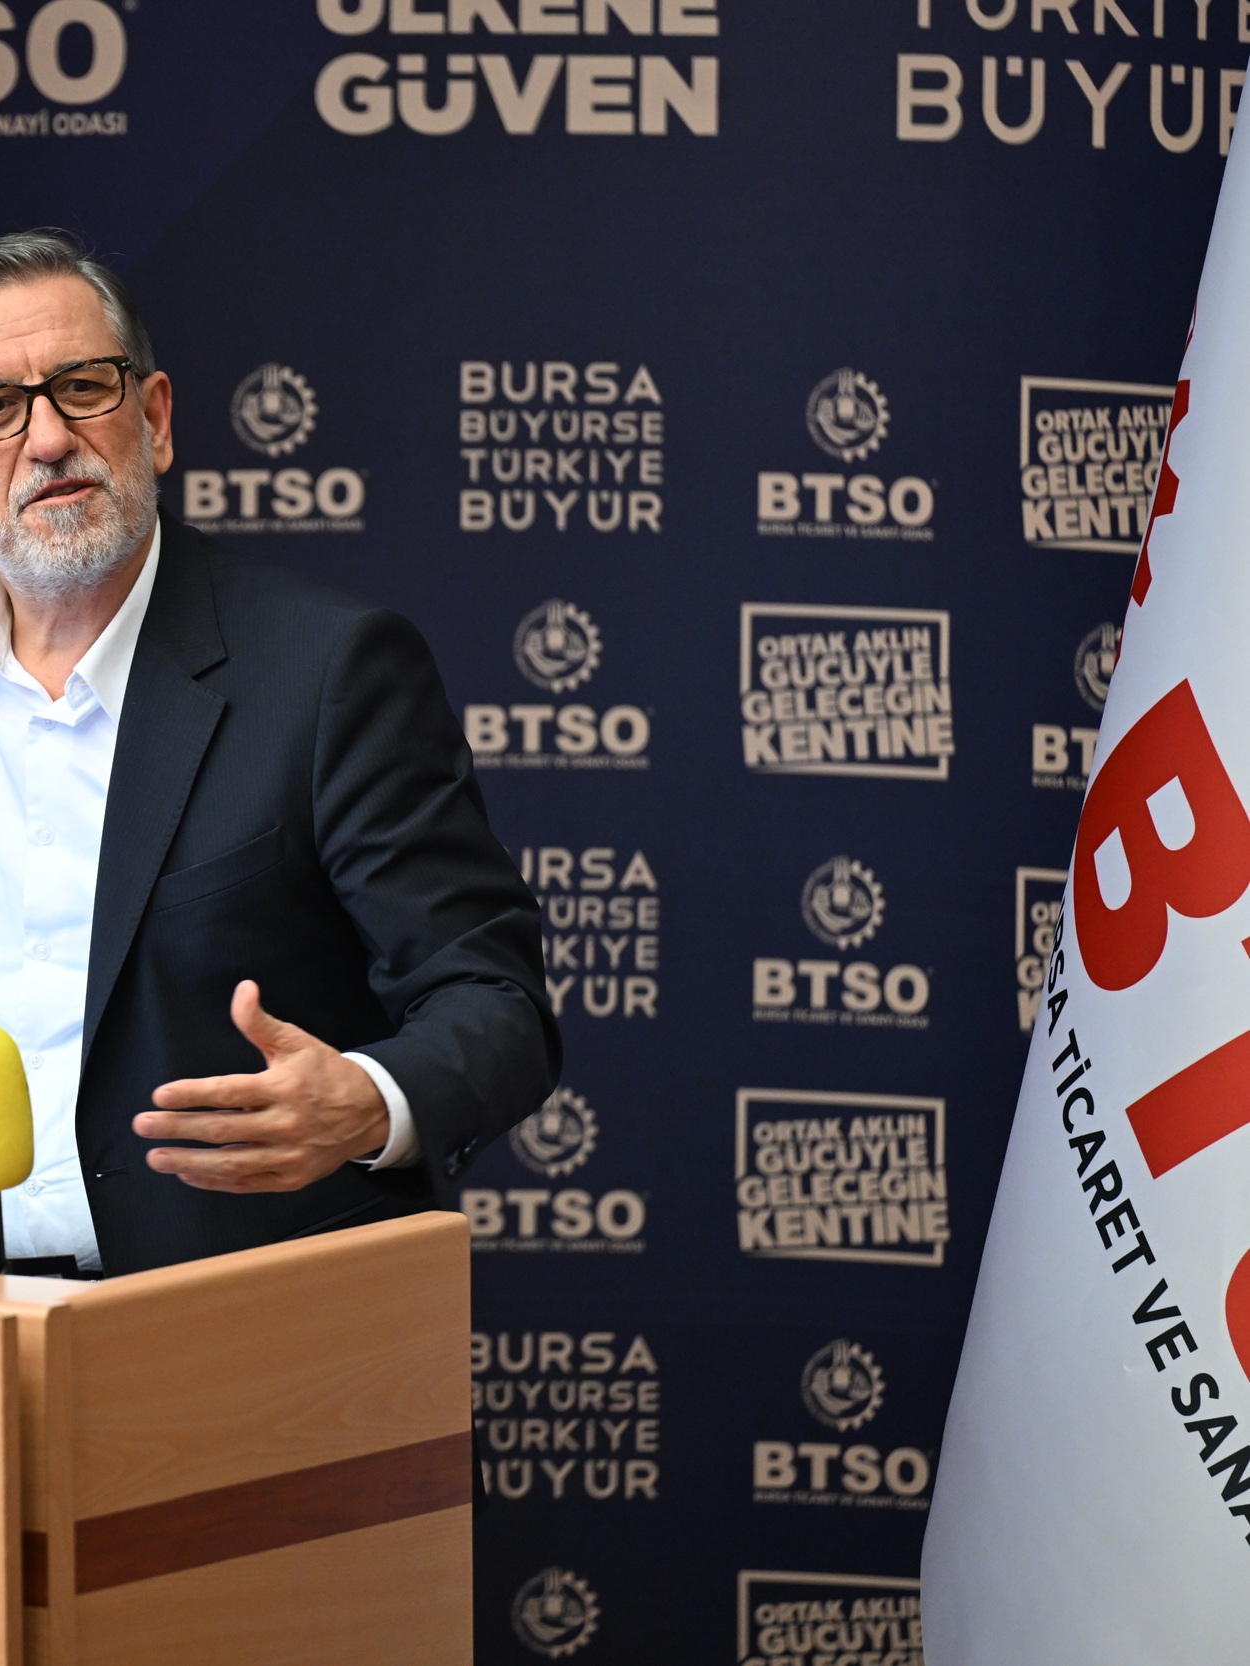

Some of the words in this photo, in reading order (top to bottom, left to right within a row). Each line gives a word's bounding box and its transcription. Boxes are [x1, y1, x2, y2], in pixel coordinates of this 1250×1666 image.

[314, 52, 721, 136] GÜVEN
[52, 111, 128, 137] ODASI
[459, 361, 662, 404] BURSA
[1035, 408, 1112, 434] ORTAK
[183, 467, 365, 519] BTSO
[459, 489, 663, 532] BÜYÜR
[757, 471, 934, 526] BTSO
[757, 631, 848, 660] ORTAK
[853, 627, 931, 651] AKLIN
[464, 704, 650, 756] BTSO
[1032, 723, 1100, 776] BT
[521, 846, 658, 893] RSA
[539, 895, 660, 931] ÜRSE
[546, 974, 659, 1018] YÜR
[752, 957, 930, 1014] BTSO
[460, 1188, 646, 1241] BTSO
[1052, 1028, 1157, 1274] TİCARET
[1132, 1277, 1198, 1373] VE
[471, 1331, 659, 1374] BURSA
[753, 1440, 930, 1497] BTSO
